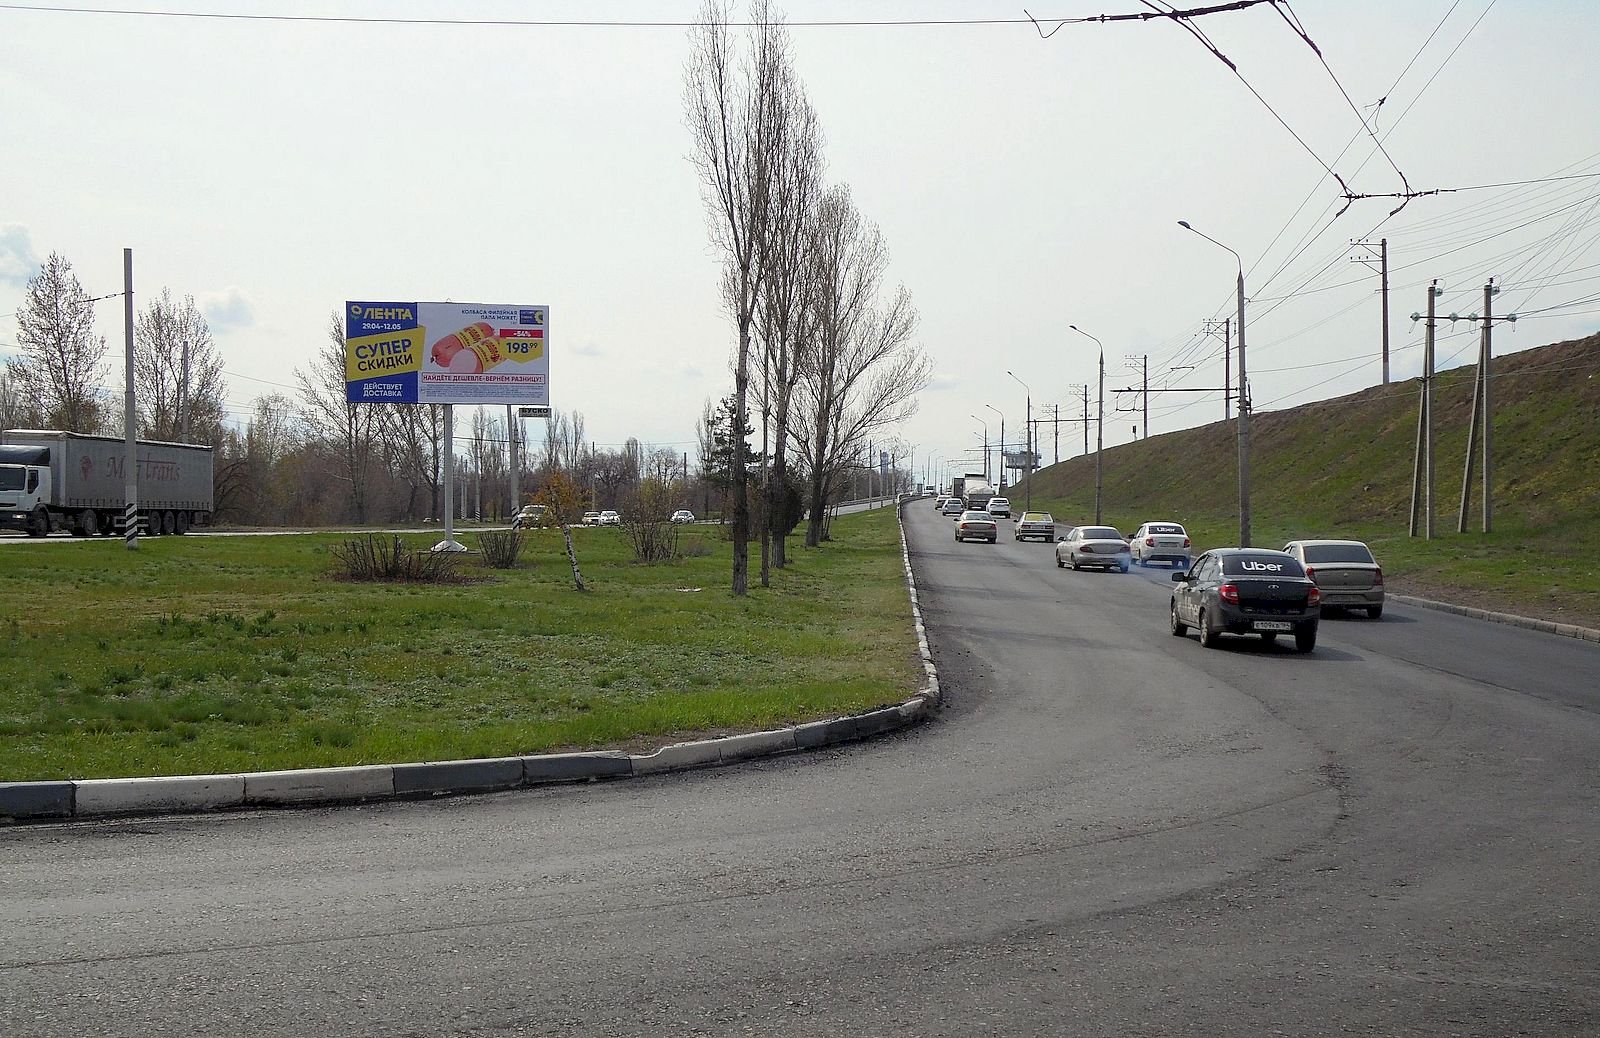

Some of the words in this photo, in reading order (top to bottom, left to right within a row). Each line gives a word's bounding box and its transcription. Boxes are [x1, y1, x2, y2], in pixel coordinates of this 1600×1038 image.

[363, 308, 413, 320] ЛЕНТА
[362, 322, 401, 330] 29.04-12.05
[513, 330, 532, 338] -54%
[355, 338, 412, 359] СУПЕР
[357, 353, 414, 372] СКИДКИ
[363, 382, 403, 390] ДЕЙСТВУЕТ
[1241, 561, 1283, 572] Uber
